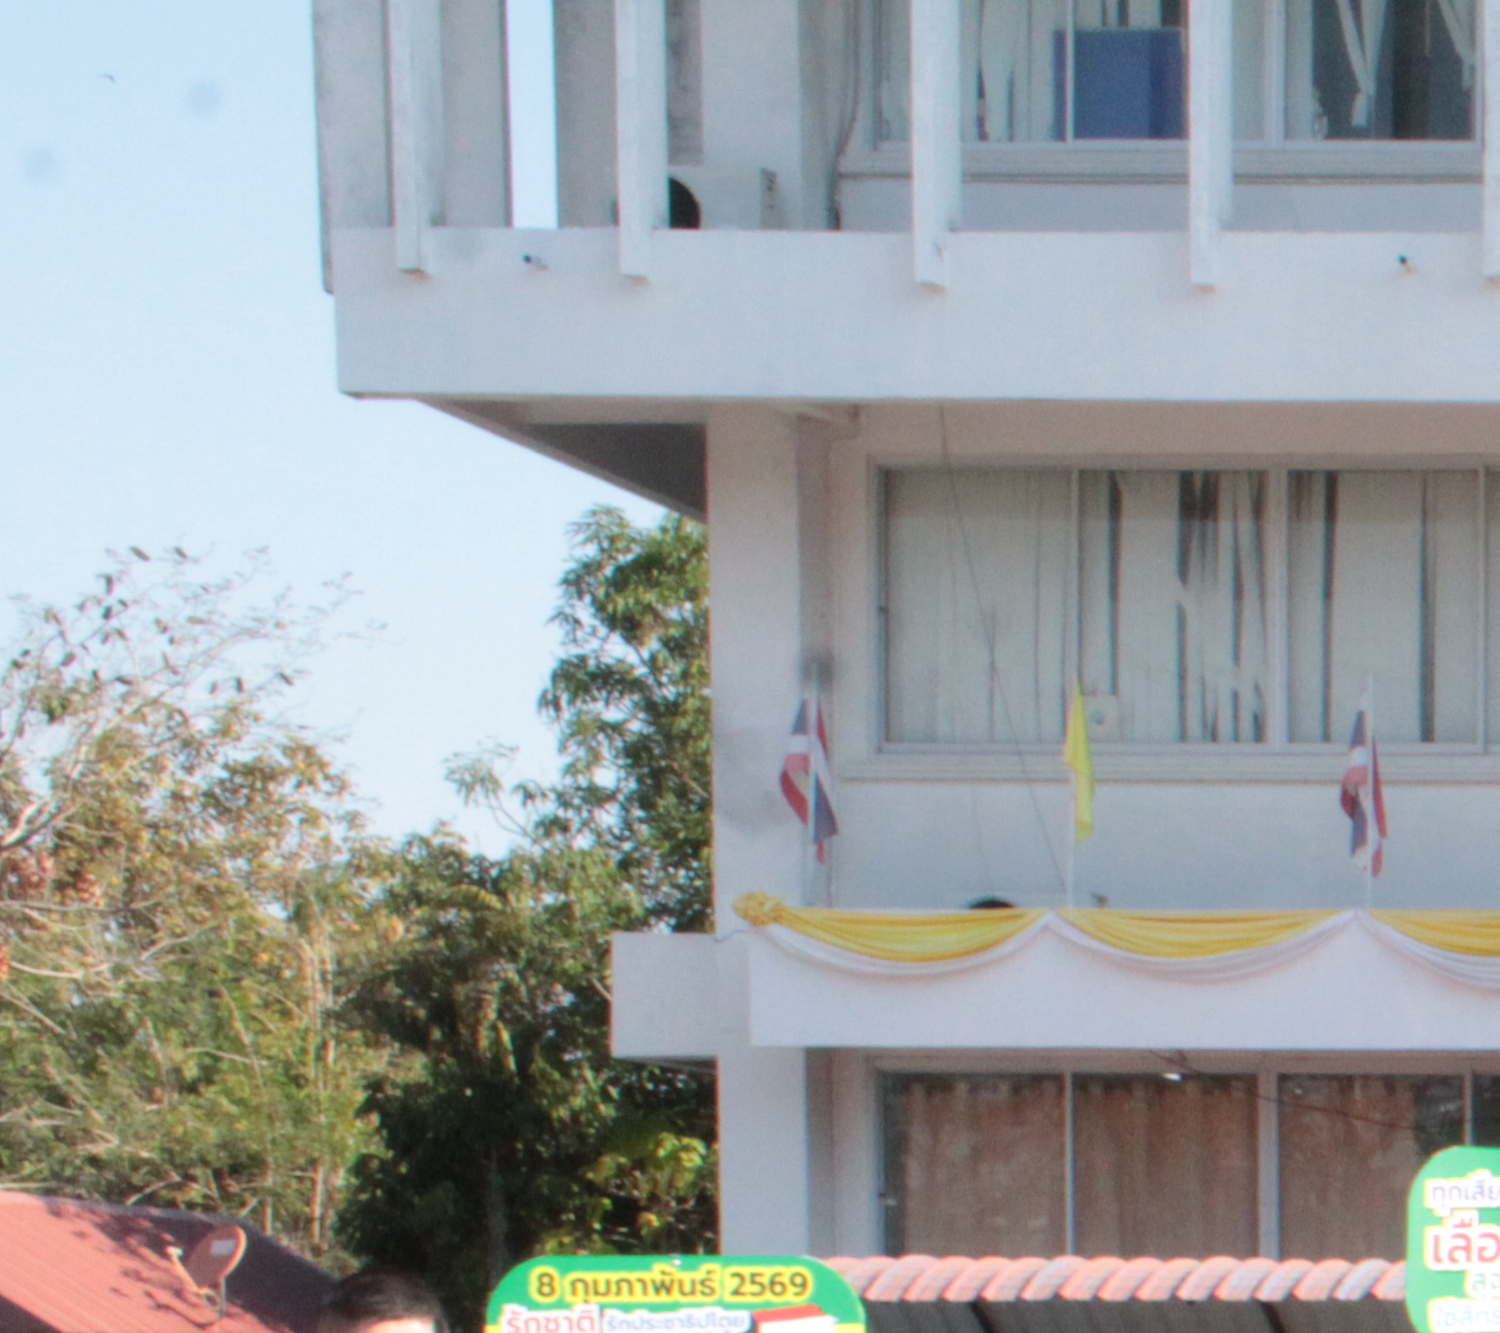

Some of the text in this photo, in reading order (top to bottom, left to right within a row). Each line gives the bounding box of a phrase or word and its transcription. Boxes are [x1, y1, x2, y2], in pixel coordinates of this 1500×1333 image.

[535, 1268, 809, 1304] 8 กุมภาพันธ์ 2569
